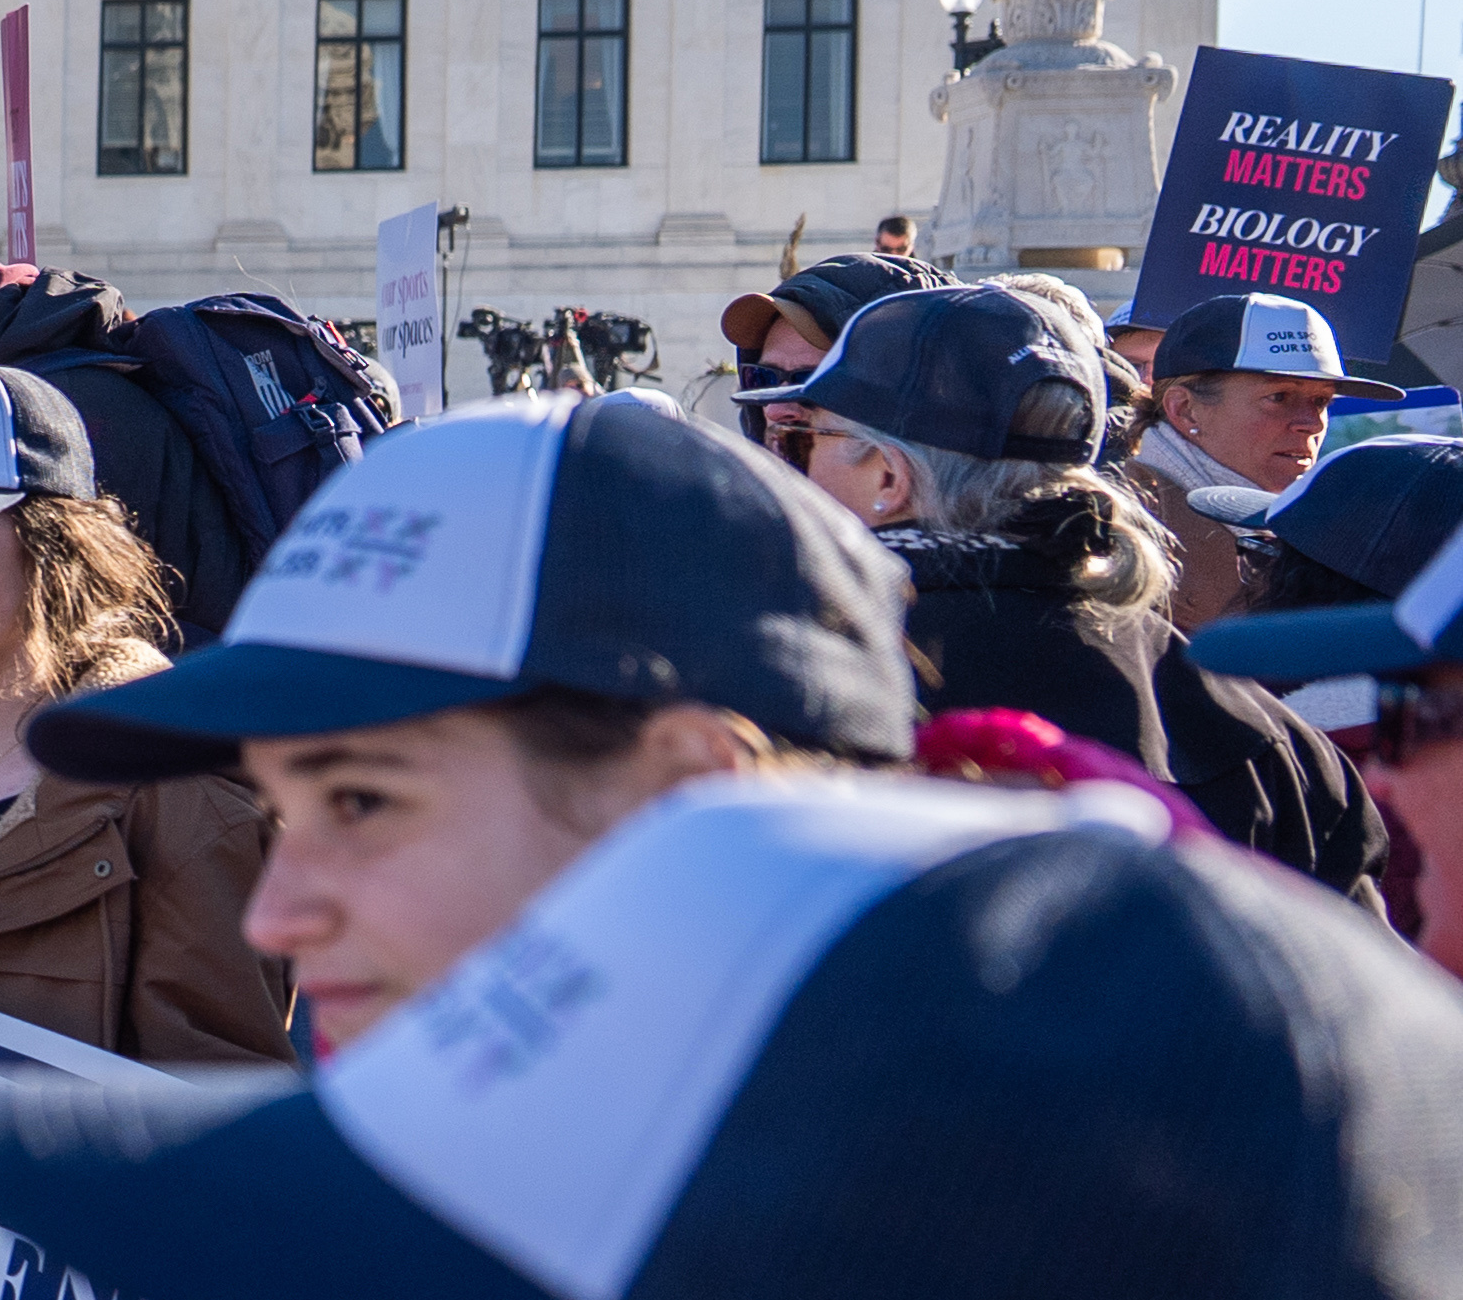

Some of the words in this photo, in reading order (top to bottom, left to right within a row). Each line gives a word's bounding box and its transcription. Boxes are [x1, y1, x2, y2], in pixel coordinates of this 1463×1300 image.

[1218, 111, 1400, 162] REALITY
[1223, 147, 1371, 201] MATTERS
[1188, 203, 1381, 257] BIOLOGY
[397, 269, 429, 314] sports
[1198, 241, 1347, 294] MATTERS
[397, 316, 433, 359] spaces
[1266, 331, 1296, 341] OUR
[1269, 344, 1299, 354] OUR
